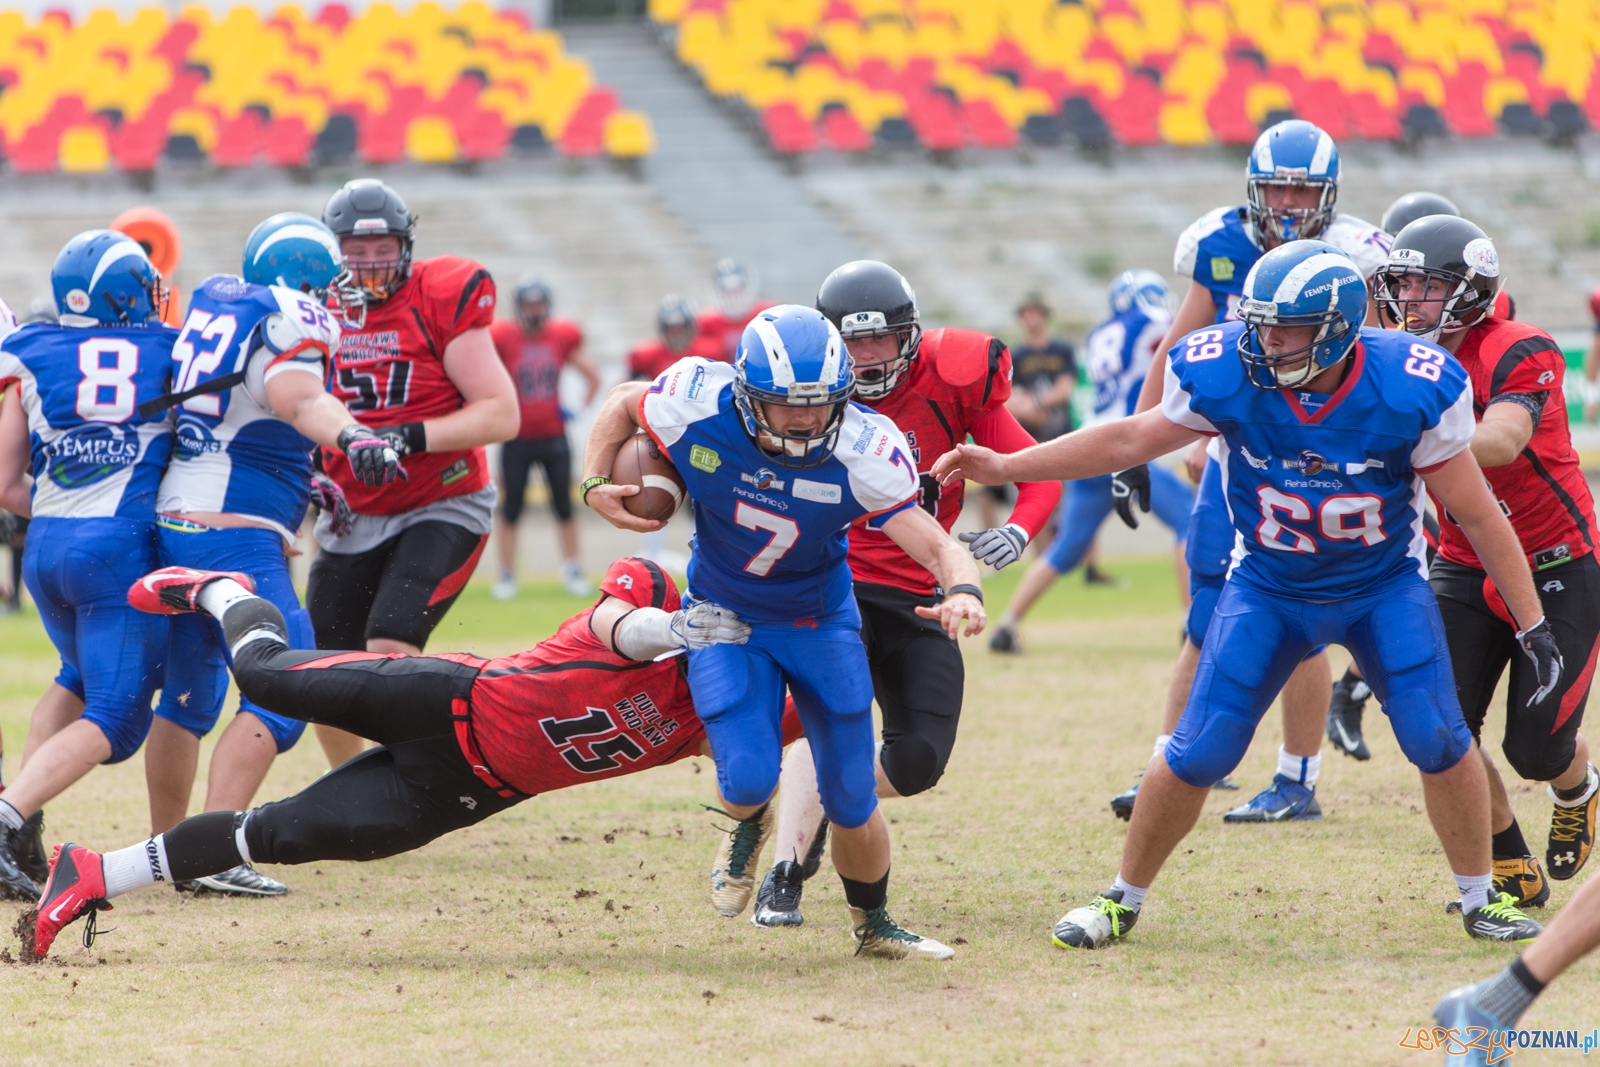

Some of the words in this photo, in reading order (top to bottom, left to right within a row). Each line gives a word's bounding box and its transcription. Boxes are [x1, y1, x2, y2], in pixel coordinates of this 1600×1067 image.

[1304, 283, 1333, 298] TEMPUS
[296, 299, 331, 334] 52
[341, 331, 399, 349] OUTLAWS
[1186, 330, 1223, 363] 69
[75, 337, 140, 424] 8
[171, 308, 237, 417] 52
[1404, 342, 1446, 382] 69
[337, 360, 414, 416] 51
[53, 436, 137, 457] TEMPUS
[888, 445, 916, 485] 7
[755, 493, 777, 507] Clinic
[1308, 479, 1331, 488] Clinic
[1255, 483, 1389, 554] 69
[734, 499, 801, 578] 7
[1541, 555, 1549, 563] L
[538, 706, 647, 774] 15
